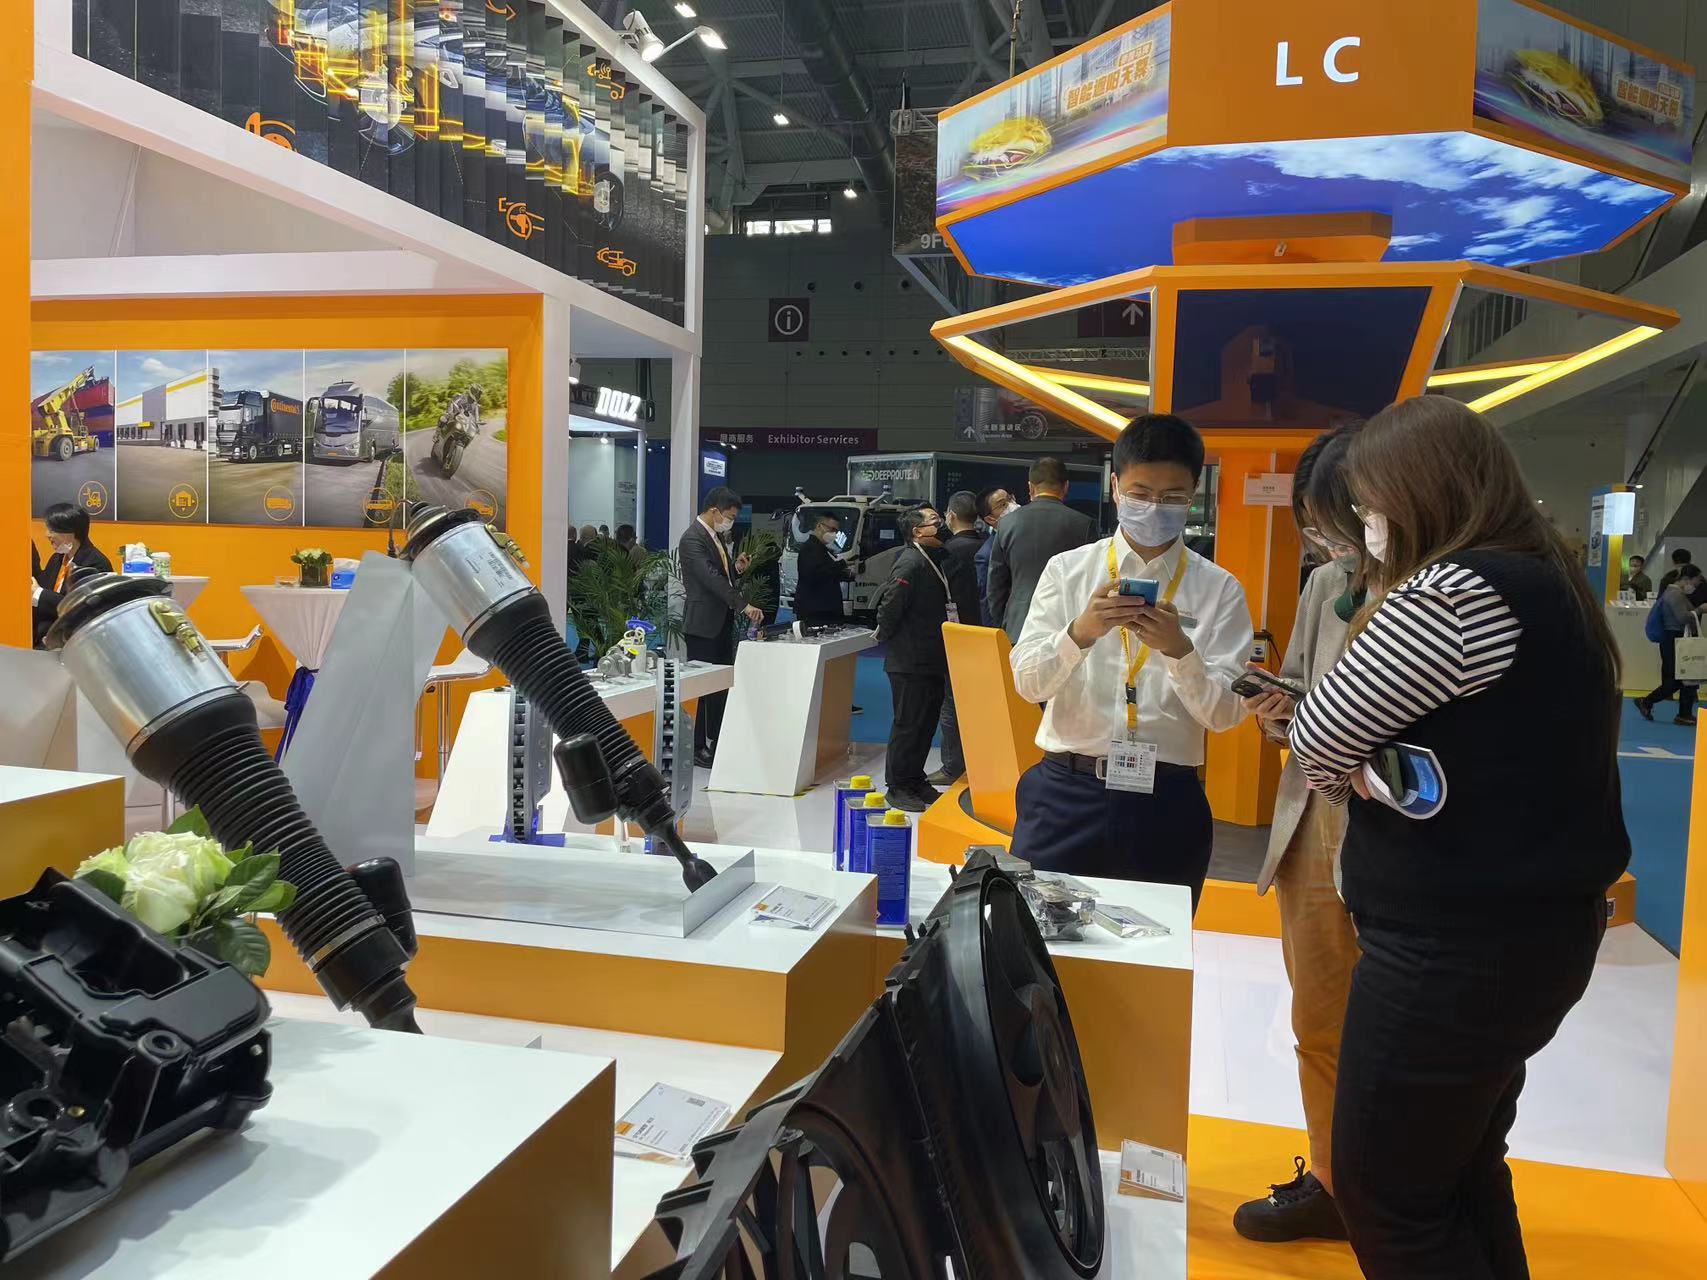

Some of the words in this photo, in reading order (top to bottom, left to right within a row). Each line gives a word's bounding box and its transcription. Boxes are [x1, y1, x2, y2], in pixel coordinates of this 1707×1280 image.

[920, 233, 950, 249] 9F
[595, 386, 642, 422] DOLZ
[768, 434, 814, 444] Exhibitor
[816, 435, 859, 445] Services
